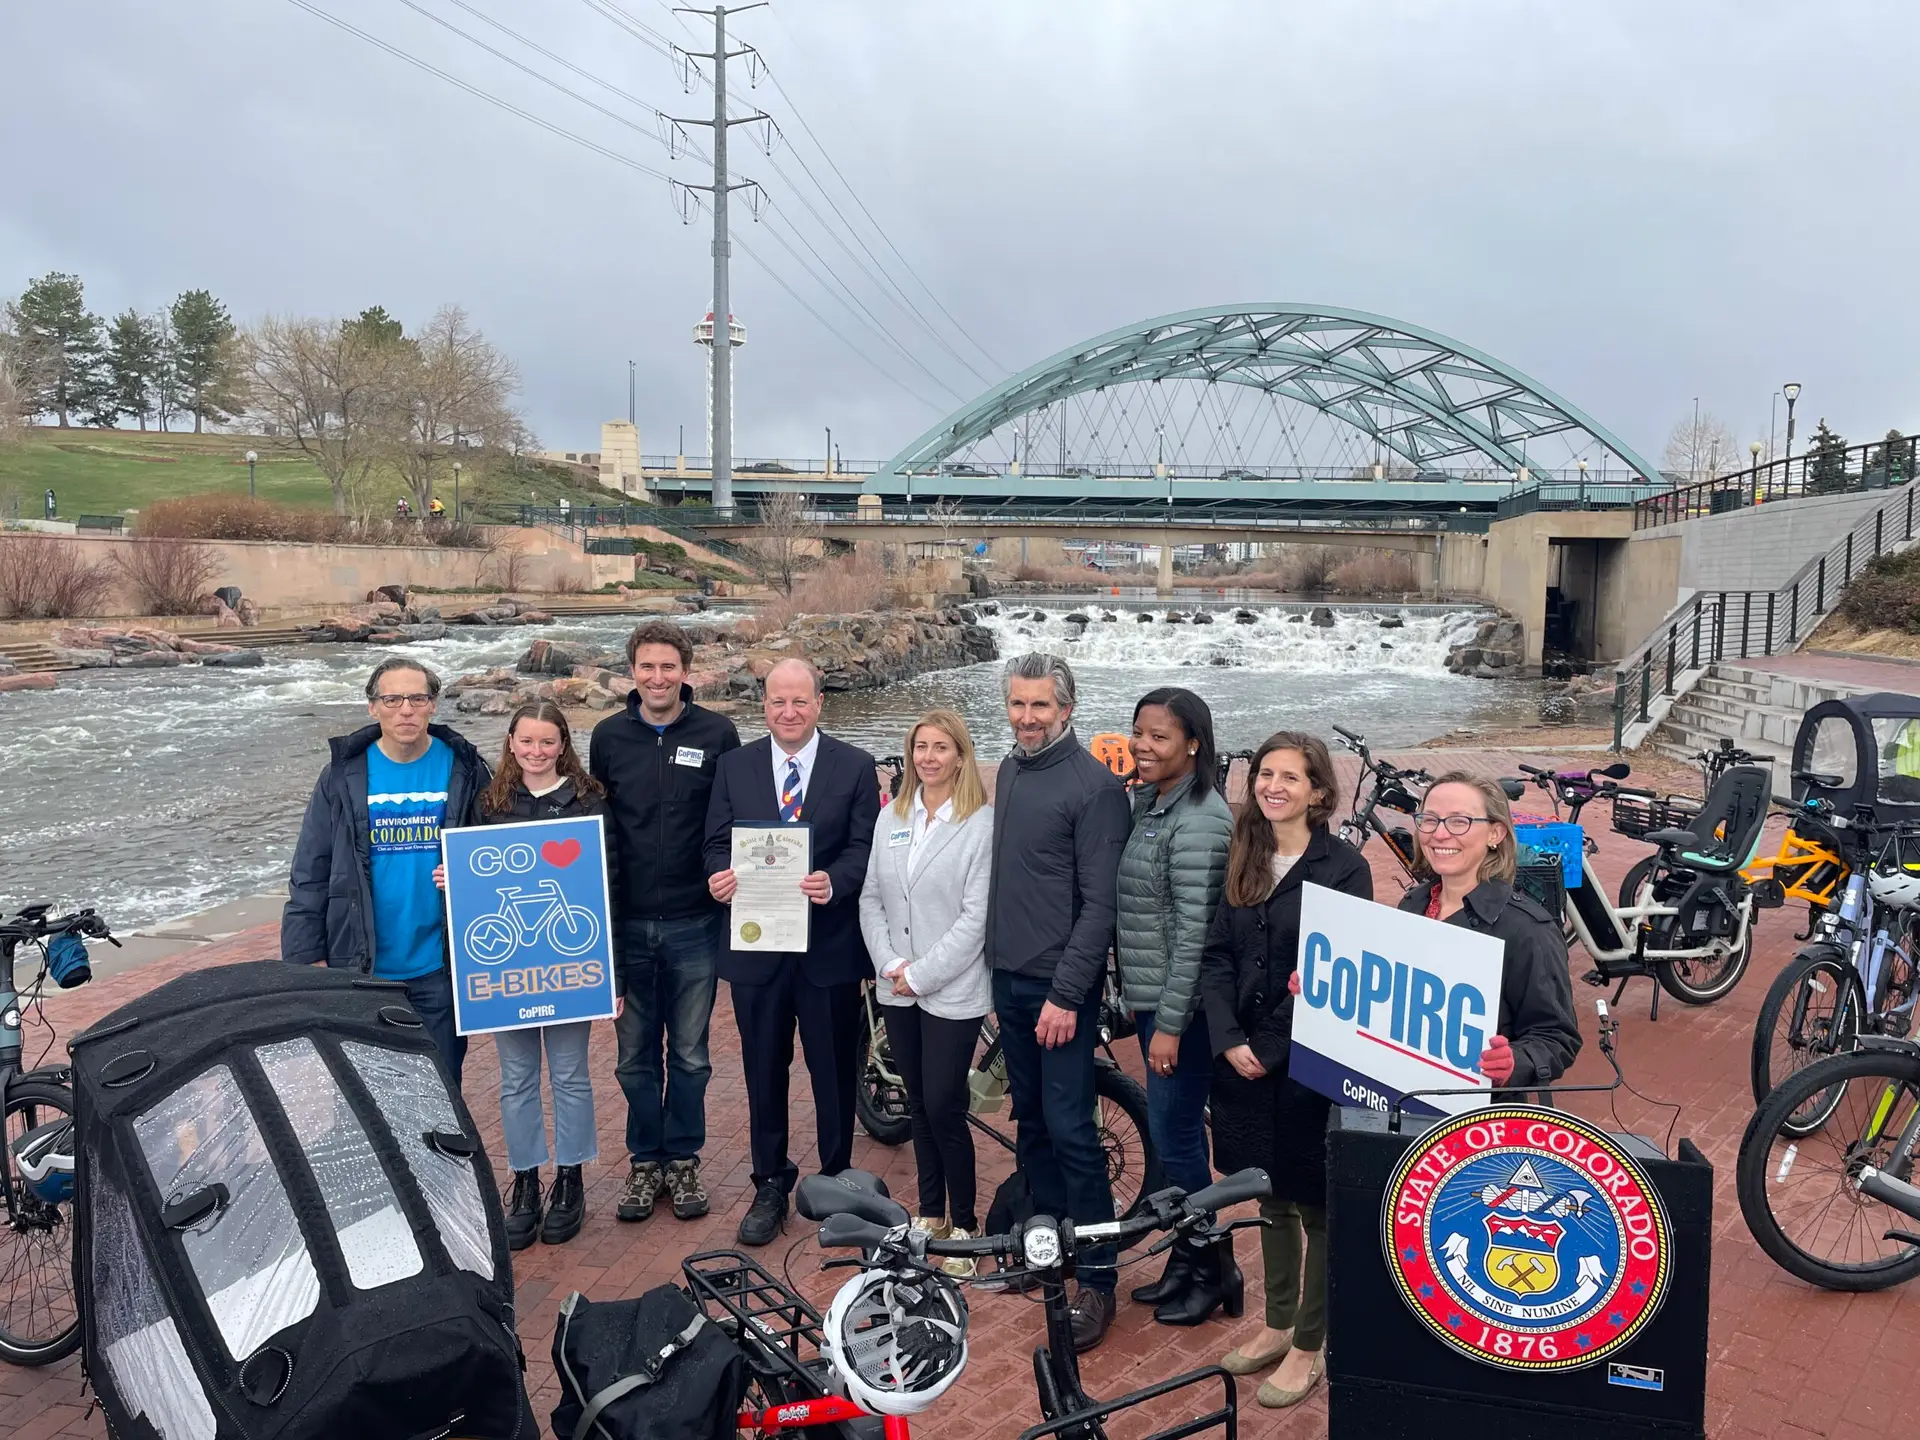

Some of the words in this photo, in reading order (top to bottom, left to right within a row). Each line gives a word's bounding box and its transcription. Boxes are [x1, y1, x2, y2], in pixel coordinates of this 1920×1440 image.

[678, 749, 703, 760] CoPIRG
[370, 826, 441, 844] COLORADO
[469, 843, 537, 877] CO
[467, 960, 604, 1001] E-BIKES
[518, 1004, 555, 1019] CoPIRG
[1303, 931, 1486, 1075] CoPIRG
[1342, 1078, 1389, 1112] CoPIRG
[1398, 1143, 1457, 1228] STATE
[1465, 1121, 1506, 1150] OF
[1526, 1123, 1656, 1261] COLORADO
[1457, 1274, 1476, 1296] NIL
[1482, 1295, 1513, 1315] SINE
[1522, 1295, 1581, 1318] NUMINE
[1476, 1326, 1558, 1359] 1876
